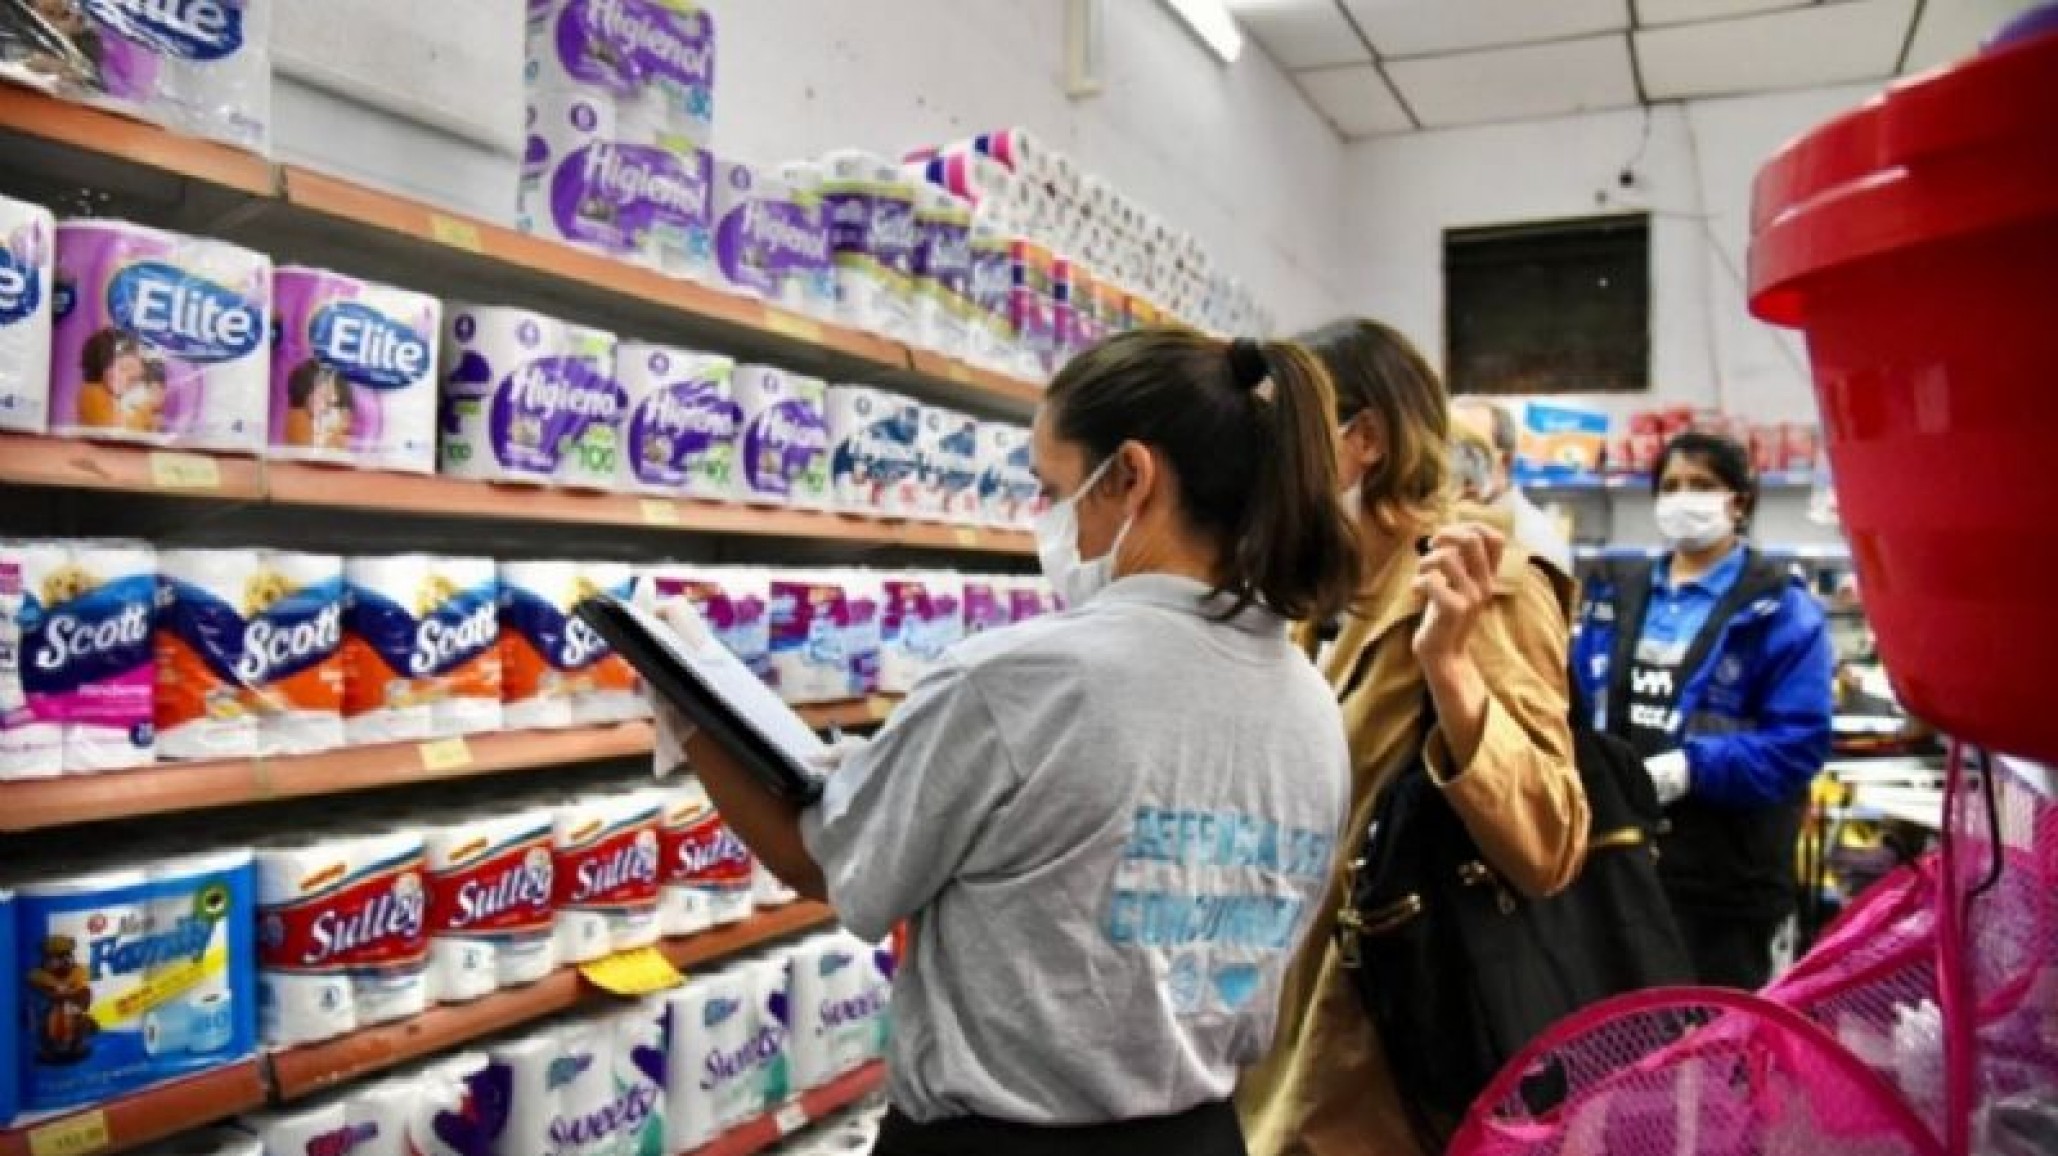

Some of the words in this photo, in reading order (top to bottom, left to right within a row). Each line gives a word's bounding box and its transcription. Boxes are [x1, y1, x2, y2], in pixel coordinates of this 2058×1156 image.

[133, 278, 252, 346] Elite
[329, 317, 424, 374] Elite
[35, 602, 148, 670] Scott
[238, 600, 342, 683] Scott
[410, 598, 498, 674] Scott
